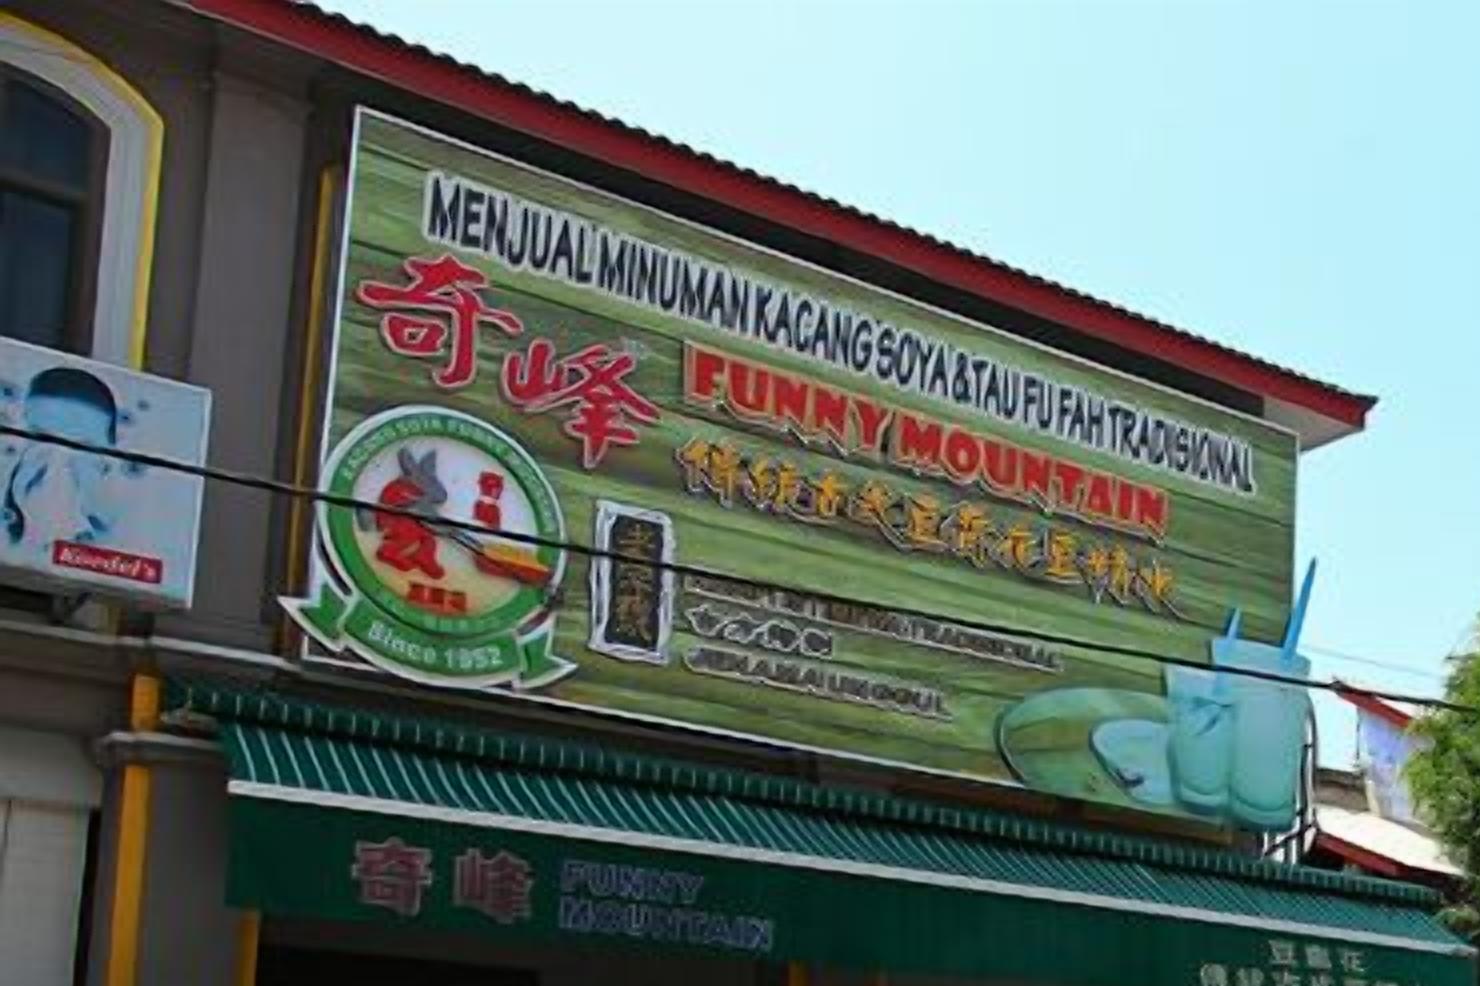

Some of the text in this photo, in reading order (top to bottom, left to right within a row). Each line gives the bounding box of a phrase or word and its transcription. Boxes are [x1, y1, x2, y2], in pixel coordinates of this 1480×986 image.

[427, 174, 593, 285] MENJUAL
[599, 233, 750, 336] MINUMAN
[754, 284, 874, 373] KACANG
[875, 327, 949, 398] SOYA
[951, 352, 970, 402] &
[970, 358, 1018, 418] TAU
[1057, 388, 1104, 448] FAH
[690, 346, 1168, 540] FUNNY MOUNTAIN
[558, 895, 774, 951] MOUNTAIN
[560, 859, 704, 904] FUNNY
